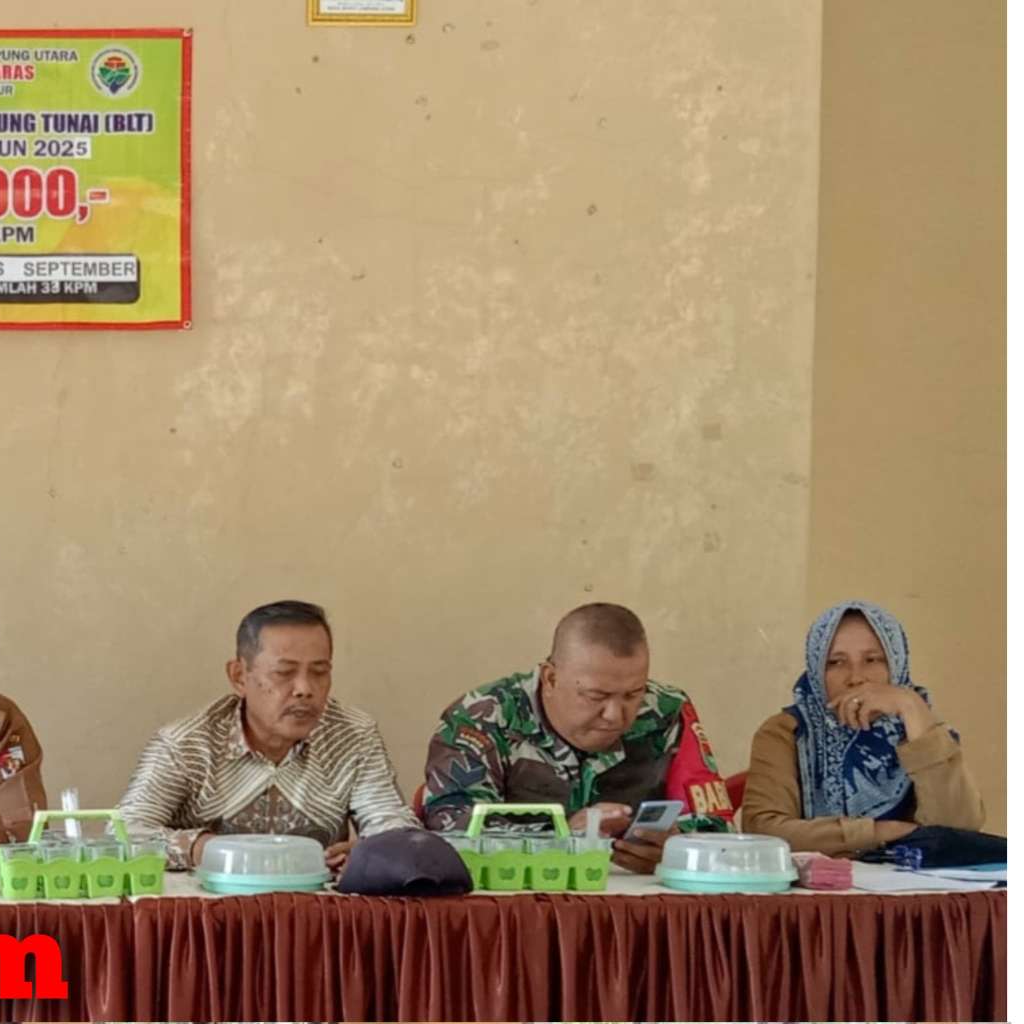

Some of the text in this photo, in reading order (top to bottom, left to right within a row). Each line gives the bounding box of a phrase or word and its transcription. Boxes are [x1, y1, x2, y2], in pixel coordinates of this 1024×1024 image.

[34, 50, 78, 61] UTARA
[41, 113, 99, 133] TUNAI
[105, 113, 153, 132] (BLT)
[34, 140, 88, 156] 2025
[23, 262, 136, 277] SEPTEMBER
[41, 282, 60, 294] 33
[64, 282, 98, 294] KPM
